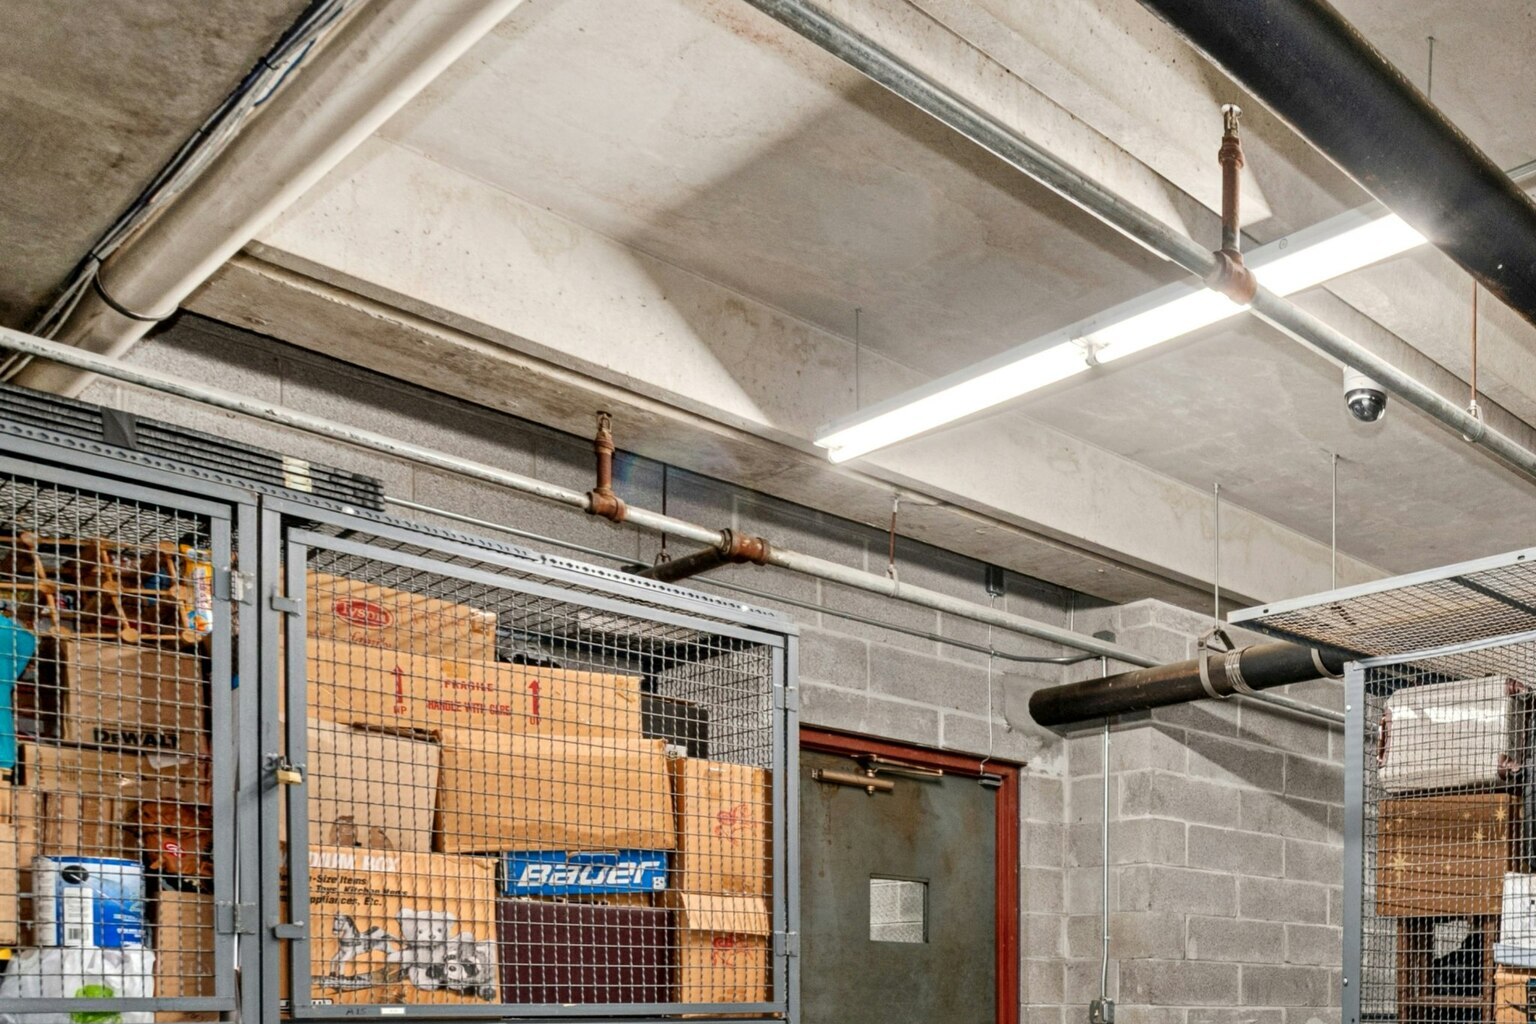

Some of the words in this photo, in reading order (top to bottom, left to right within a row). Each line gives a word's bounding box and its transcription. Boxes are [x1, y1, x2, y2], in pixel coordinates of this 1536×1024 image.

[341, 601, 388, 624] Tyson
[443, 680, 494, 693] FRAGILE
[393, 705, 408, 716] UP
[427, 699, 462, 713] HANDLE
[363, 896, 383, 906] Etc.
